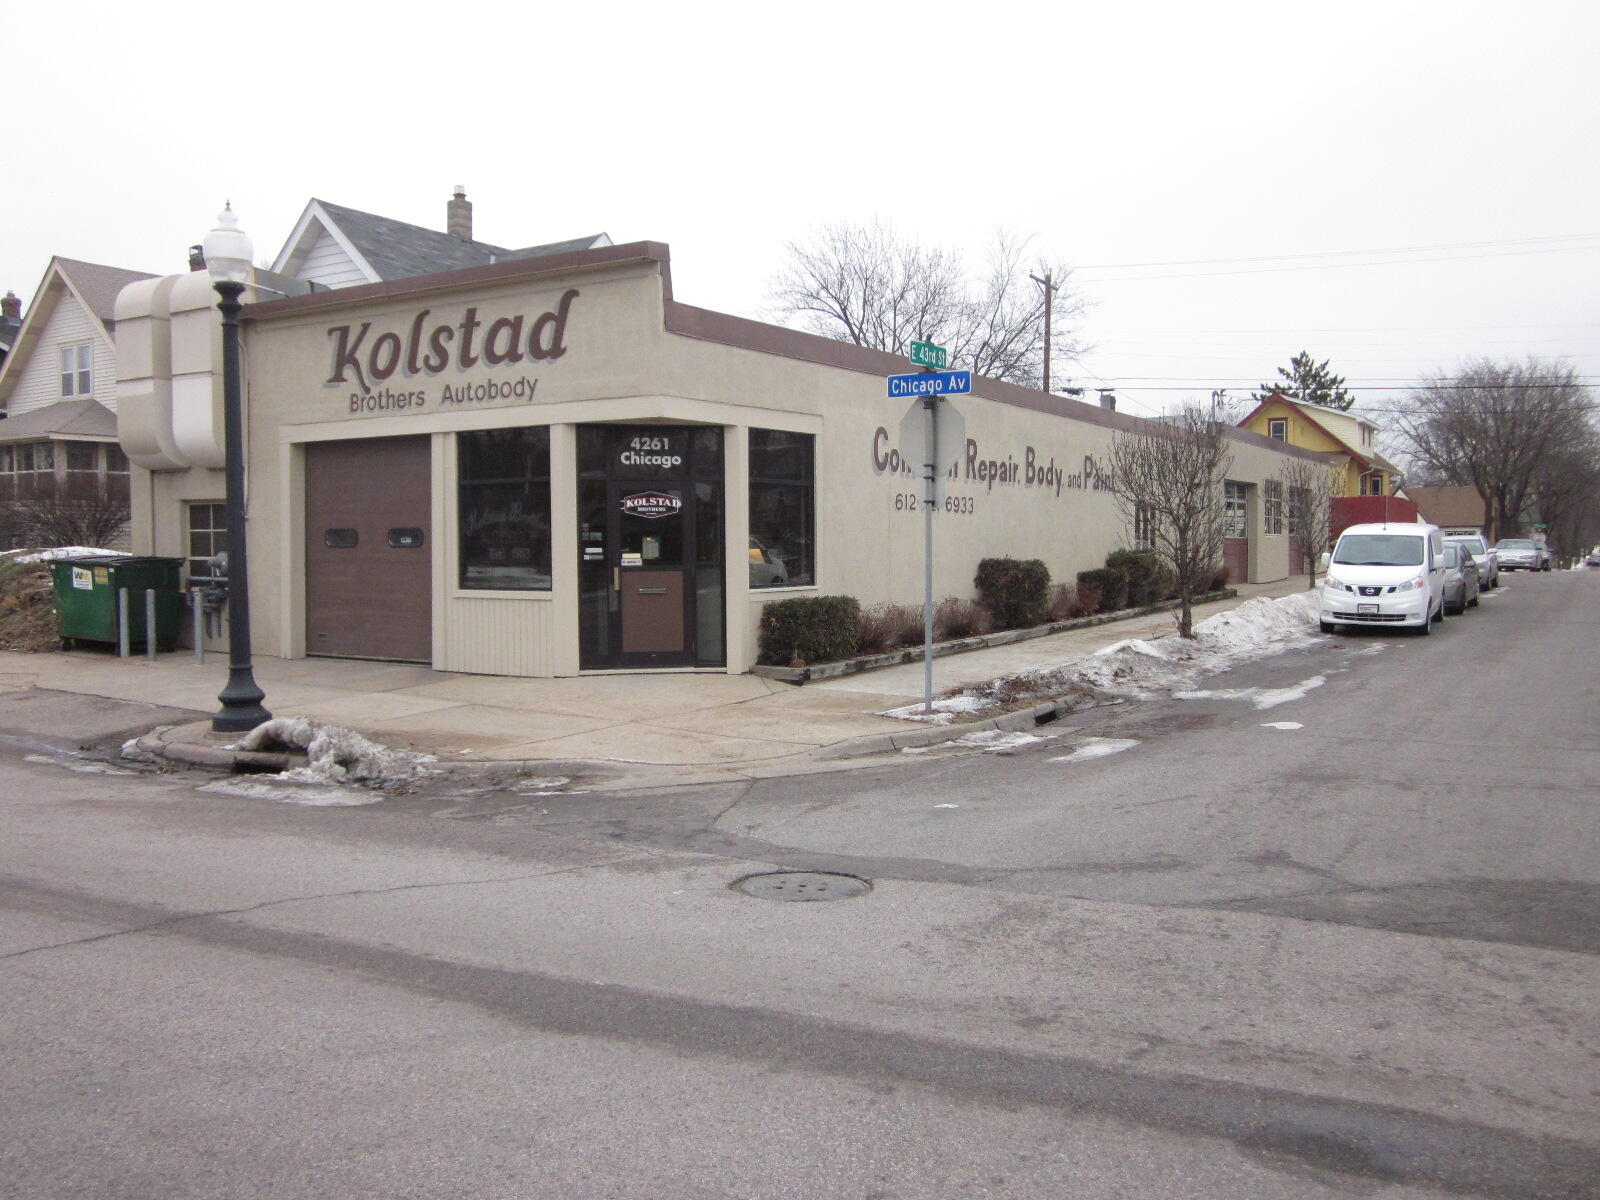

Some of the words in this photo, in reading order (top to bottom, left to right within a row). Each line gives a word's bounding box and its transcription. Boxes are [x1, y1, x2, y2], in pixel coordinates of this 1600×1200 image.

[326, 288, 580, 395] Kolstad
[911, 345, 917, 359] E
[919, 346, 936, 363] 43rd
[938, 350, 945, 366] St
[349, 388, 426, 413] Brothers
[440, 376, 539, 405] Autobody
[892, 378, 943, 395] Chicago
[948, 375, 966, 390] Av
[630, 437, 669, 450] 4261
[620, 451, 682, 469] Chicago
[1067, 471, 1082, 489] and
[626, 497, 682, 508] KOLSTAD
[895, 493, 916, 511] 612
[945, 496, 974, 514] 6933
